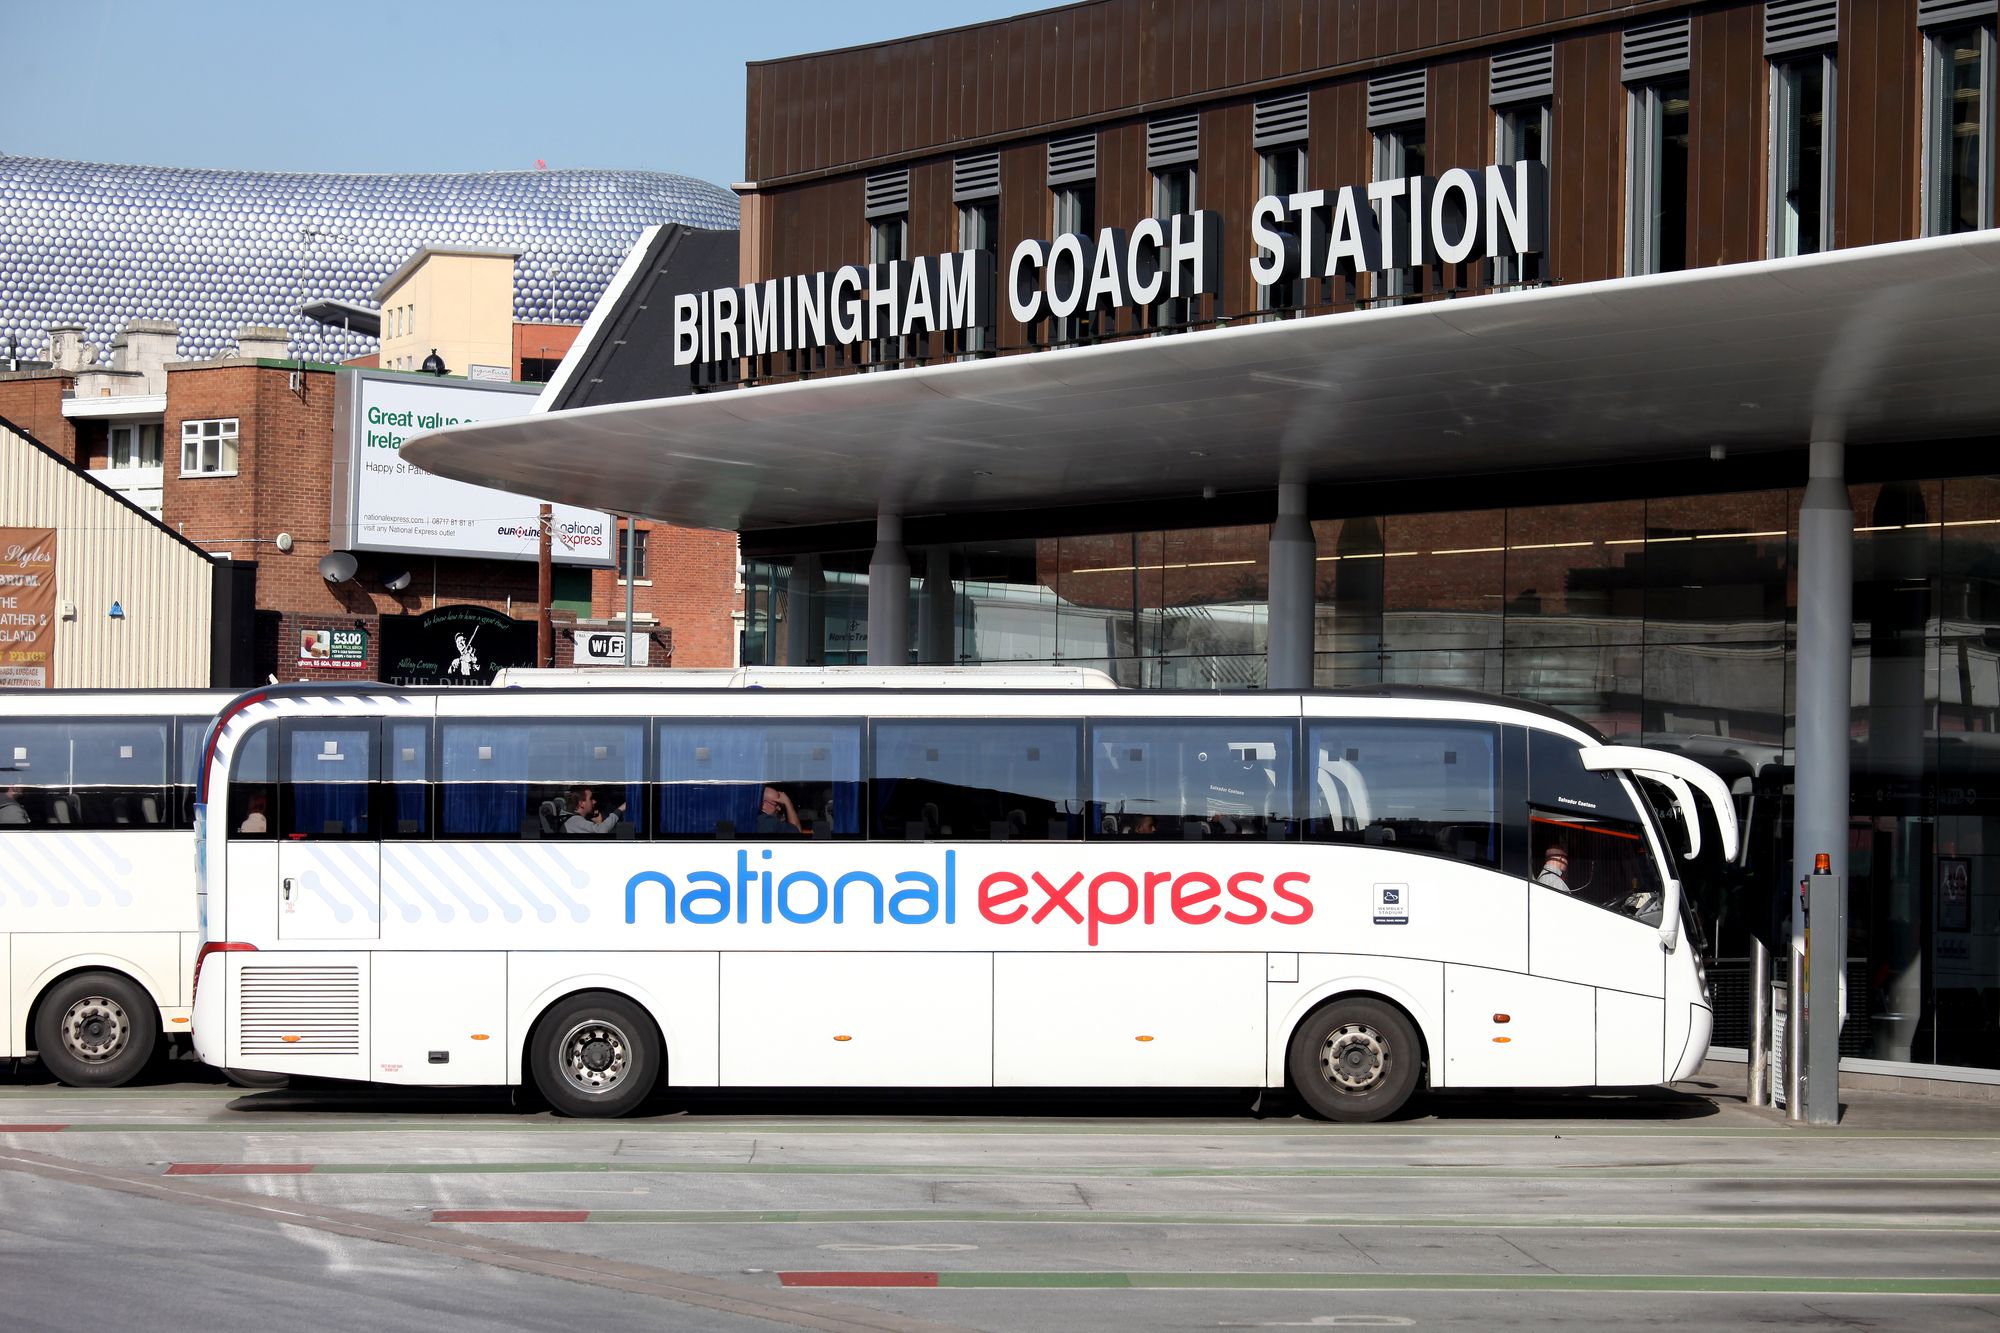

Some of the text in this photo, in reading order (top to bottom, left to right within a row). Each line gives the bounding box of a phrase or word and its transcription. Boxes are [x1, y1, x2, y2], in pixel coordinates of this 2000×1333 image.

[674, 160, 1529, 366] BIRMINGHAM COACH STATION
[368, 407, 414, 427] Great
[367, 430, 413, 449] Irela
[366, 462, 393, 475] Happy
[396, 463, 405, 473] St
[364, 513, 423, 524] nationalexpress.com
[389, 526, 413, 534] National
[415, 527, 438, 536] Express
[560, 521, 602, 535] national
[562, 535, 602, 547] express
[5, 545, 52, 568] Styles
[0, 614, 47, 626] ATHER &
[0, 631, 36, 642] GLAND
[334, 633, 361, 645] £3.00
[9, 652, 46, 662] PRICE
[626, 850, 1313, 946] national express
